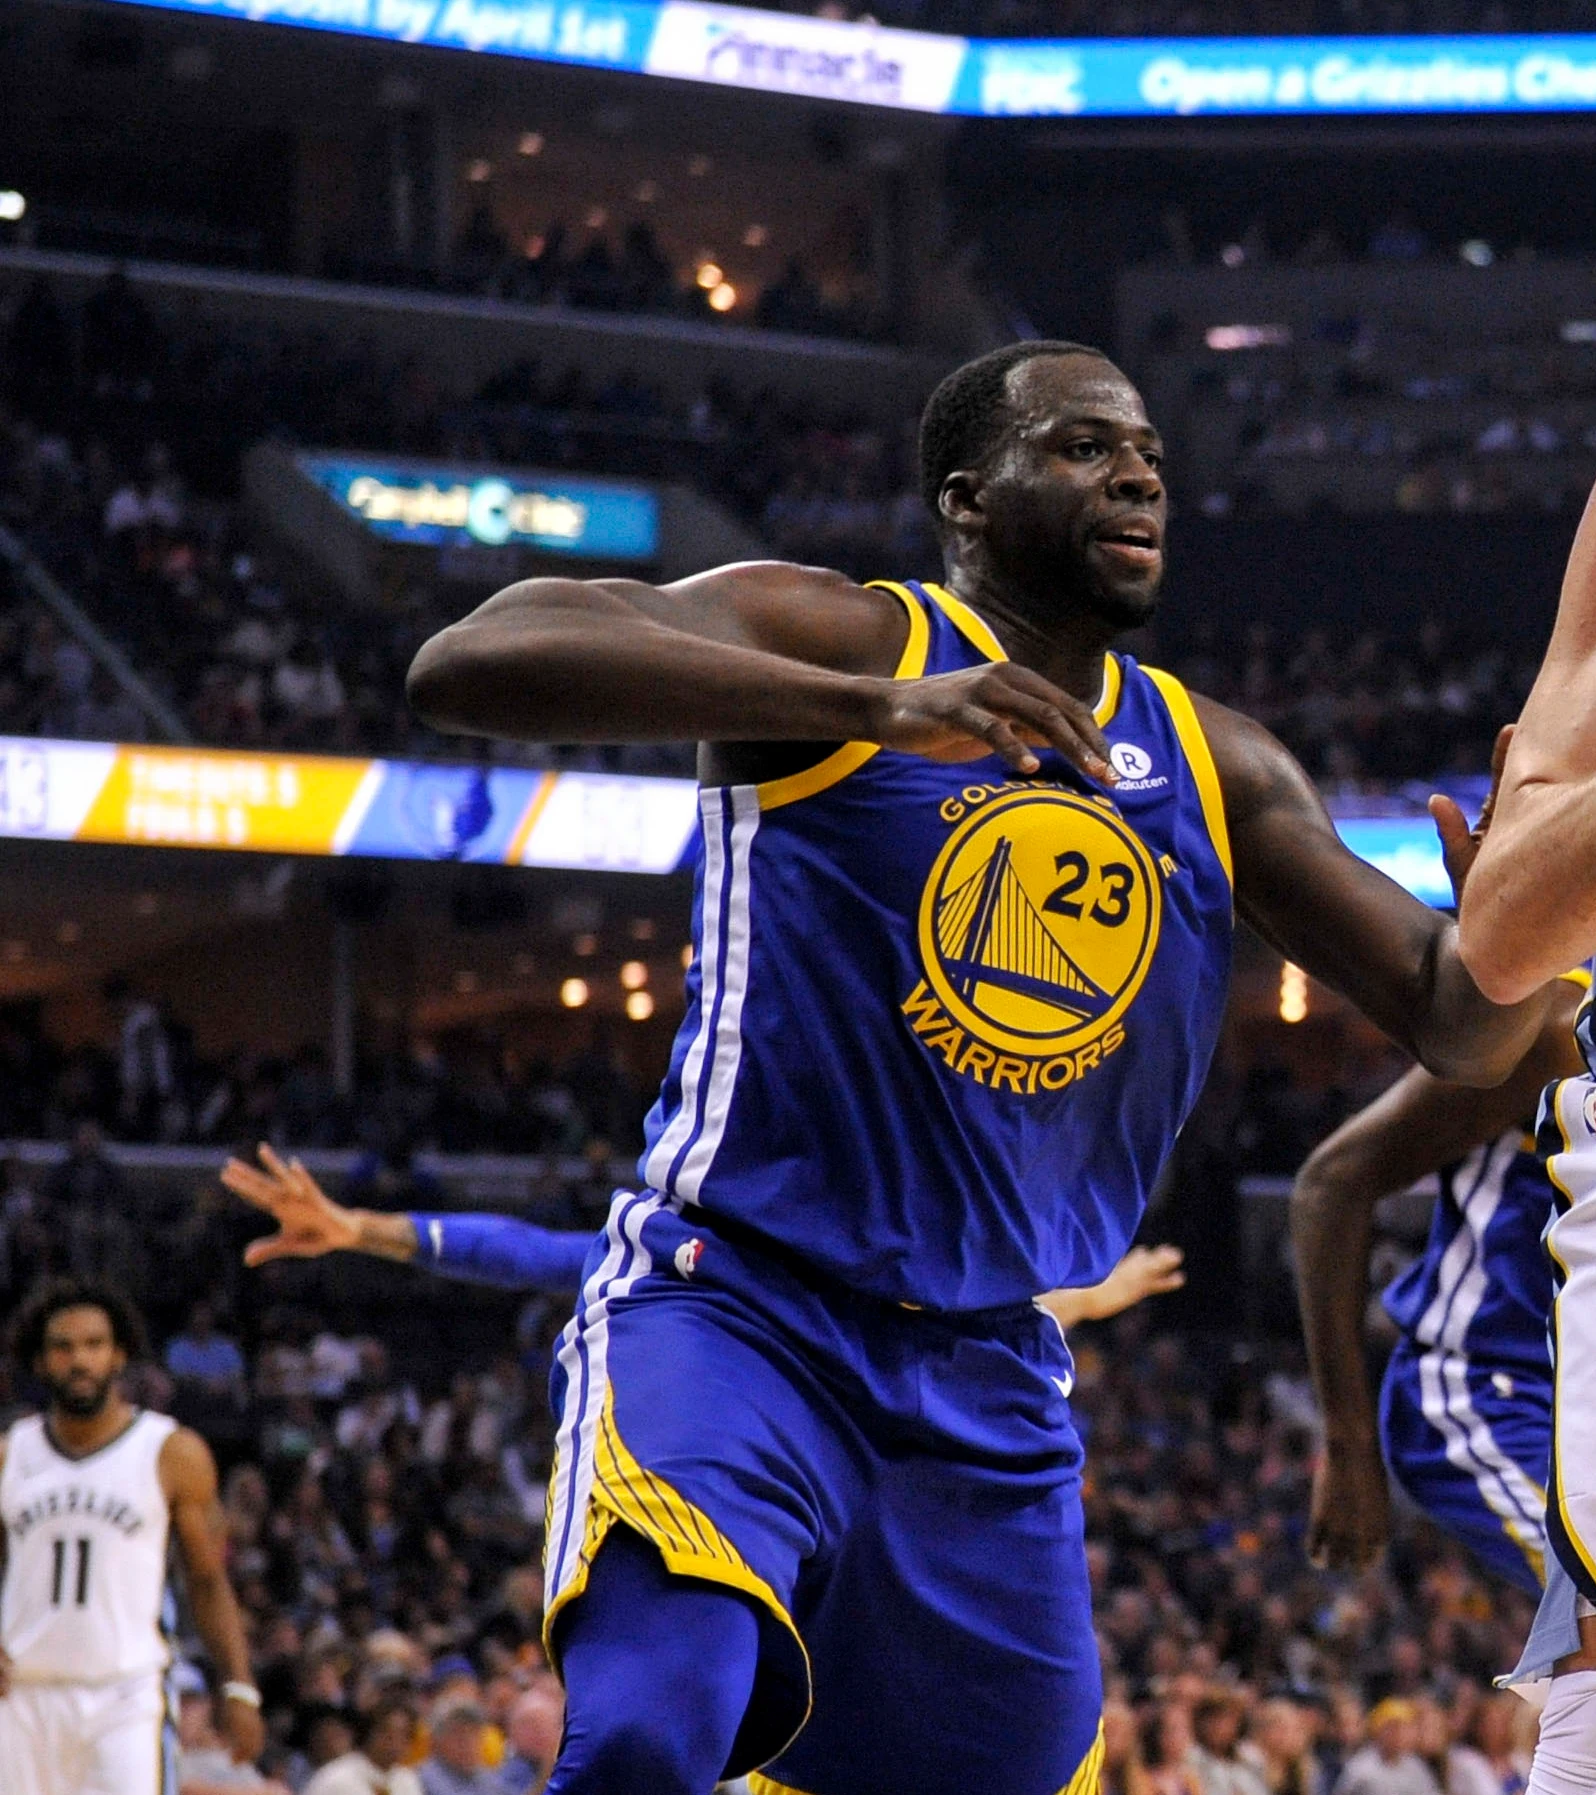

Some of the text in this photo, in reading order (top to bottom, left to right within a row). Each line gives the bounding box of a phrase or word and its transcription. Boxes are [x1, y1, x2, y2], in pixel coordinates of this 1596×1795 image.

[1139, 57, 1272, 115] Open
[1275, 66, 1306, 103] a
[1311, 56, 1507, 104] Grizzlies
[1041, 850, 1135, 928] 23
[901, 977, 1126, 1095] WARRIORS
[52, 1537, 91, 1607] 11
